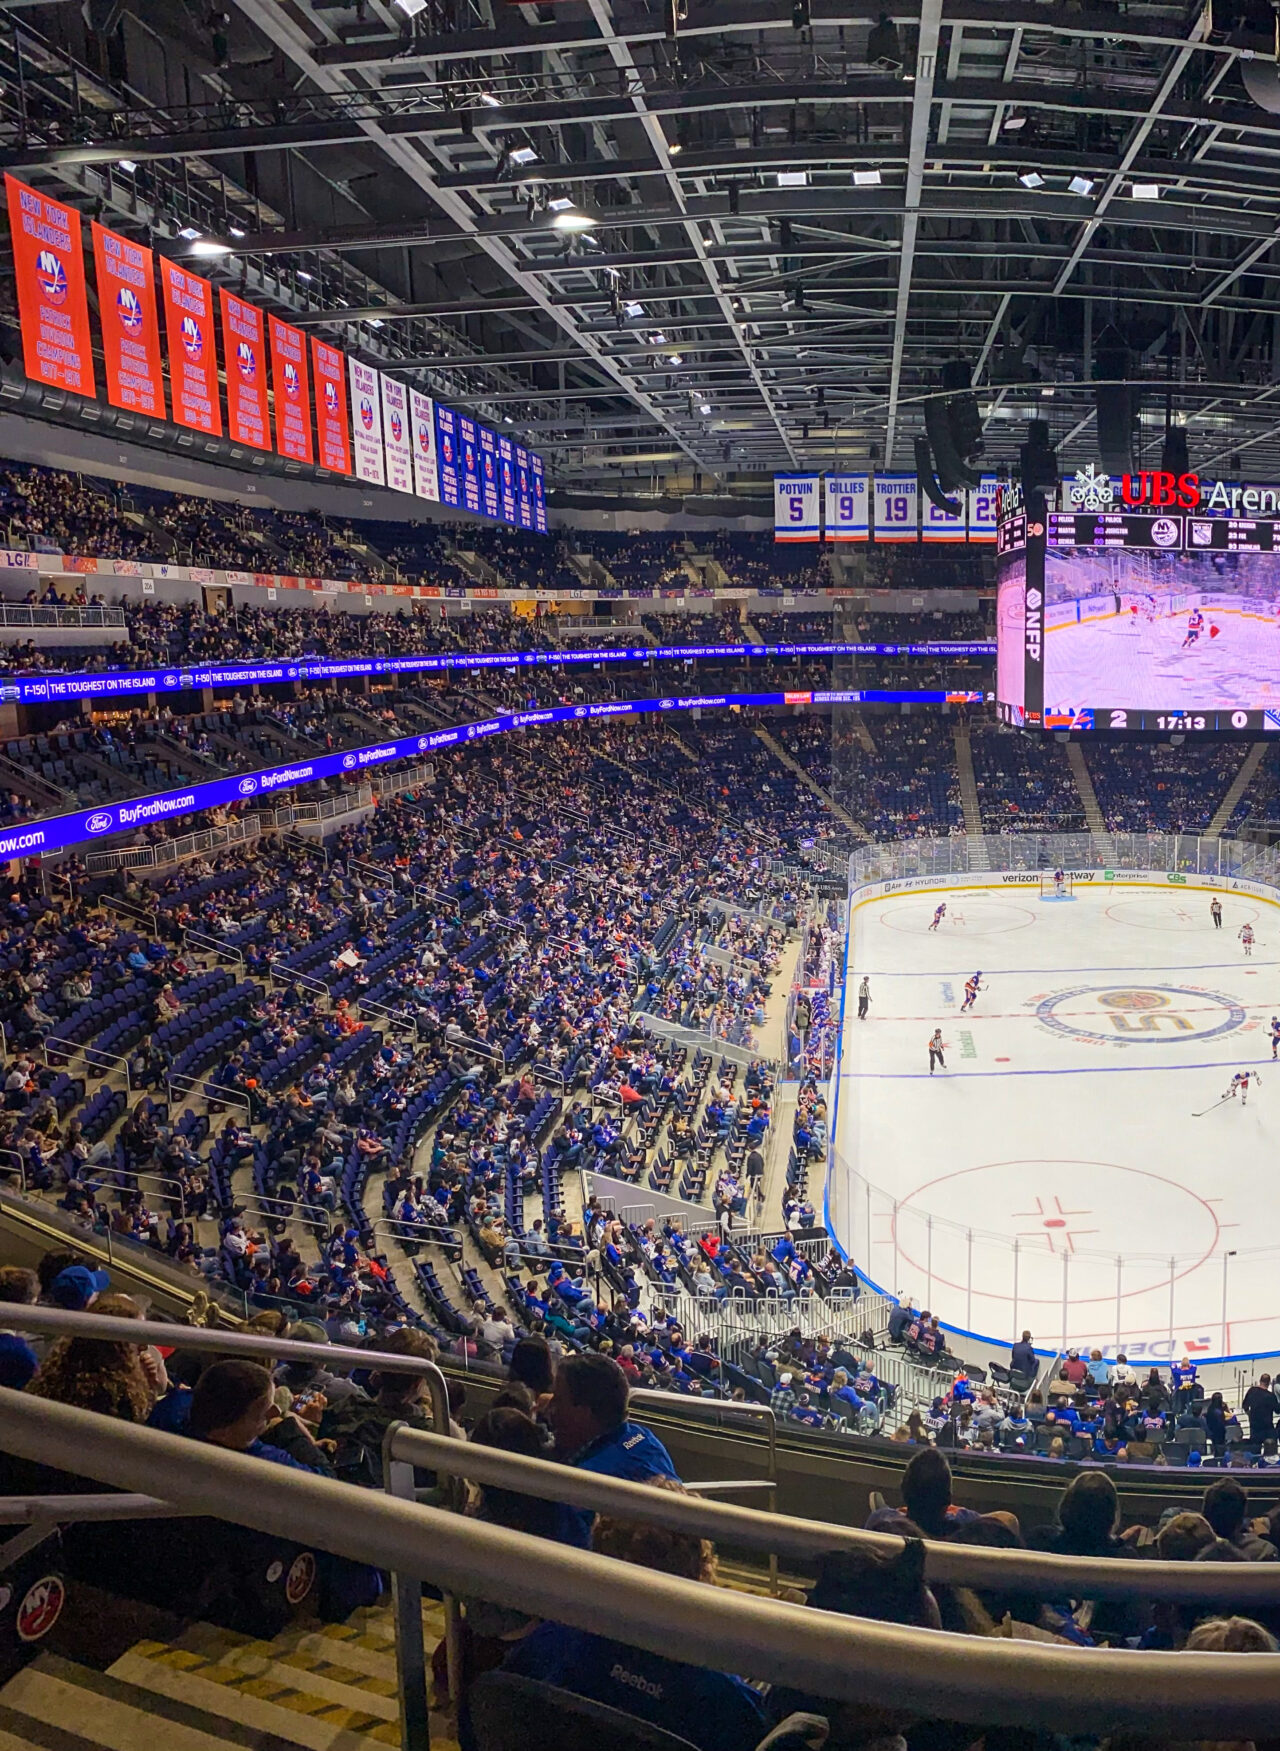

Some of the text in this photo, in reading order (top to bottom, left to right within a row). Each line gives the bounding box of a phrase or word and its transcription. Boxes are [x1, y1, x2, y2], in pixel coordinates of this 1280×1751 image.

[19, 189, 69, 231] NEW YORK
[22, 212, 72, 253] ISLANDERS
[103, 233, 144, 268] NEW YORK
[105, 254, 146, 289] ISLANDERS
[169, 267, 204, 299] NEW YORK
[171, 286, 206, 318] ISLANDERS
[779, 483, 813, 495] POTVIN
[829, 482, 864, 494] GILLIES
[876, 483, 916, 494] TROTTIER
[1122, 471, 1199, 508] UBS
[790, 497, 803, 521] 5
[840, 496, 853, 520] 9
[885, 497, 908, 521] 19
[1026, 610, 1040, 659] NFP
[24, 677, 155, 696] F-150 THE TOUGHEST ON THE ISLAND
[590, 705, 632, 714] BuyFordNow.com
[678, 698, 726, 707] BuyFordNow.com
[1110, 710, 1248, 730] 2 17:13 0
[261, 767, 313, 787] BuyFordNow.com
[120, 795, 195, 823] BuyFordNow.com
[1002, 873, 1039, 883] verizon
[622, 1433, 646, 1450] Reebok
[610, 1664, 664, 1700] Reebok
